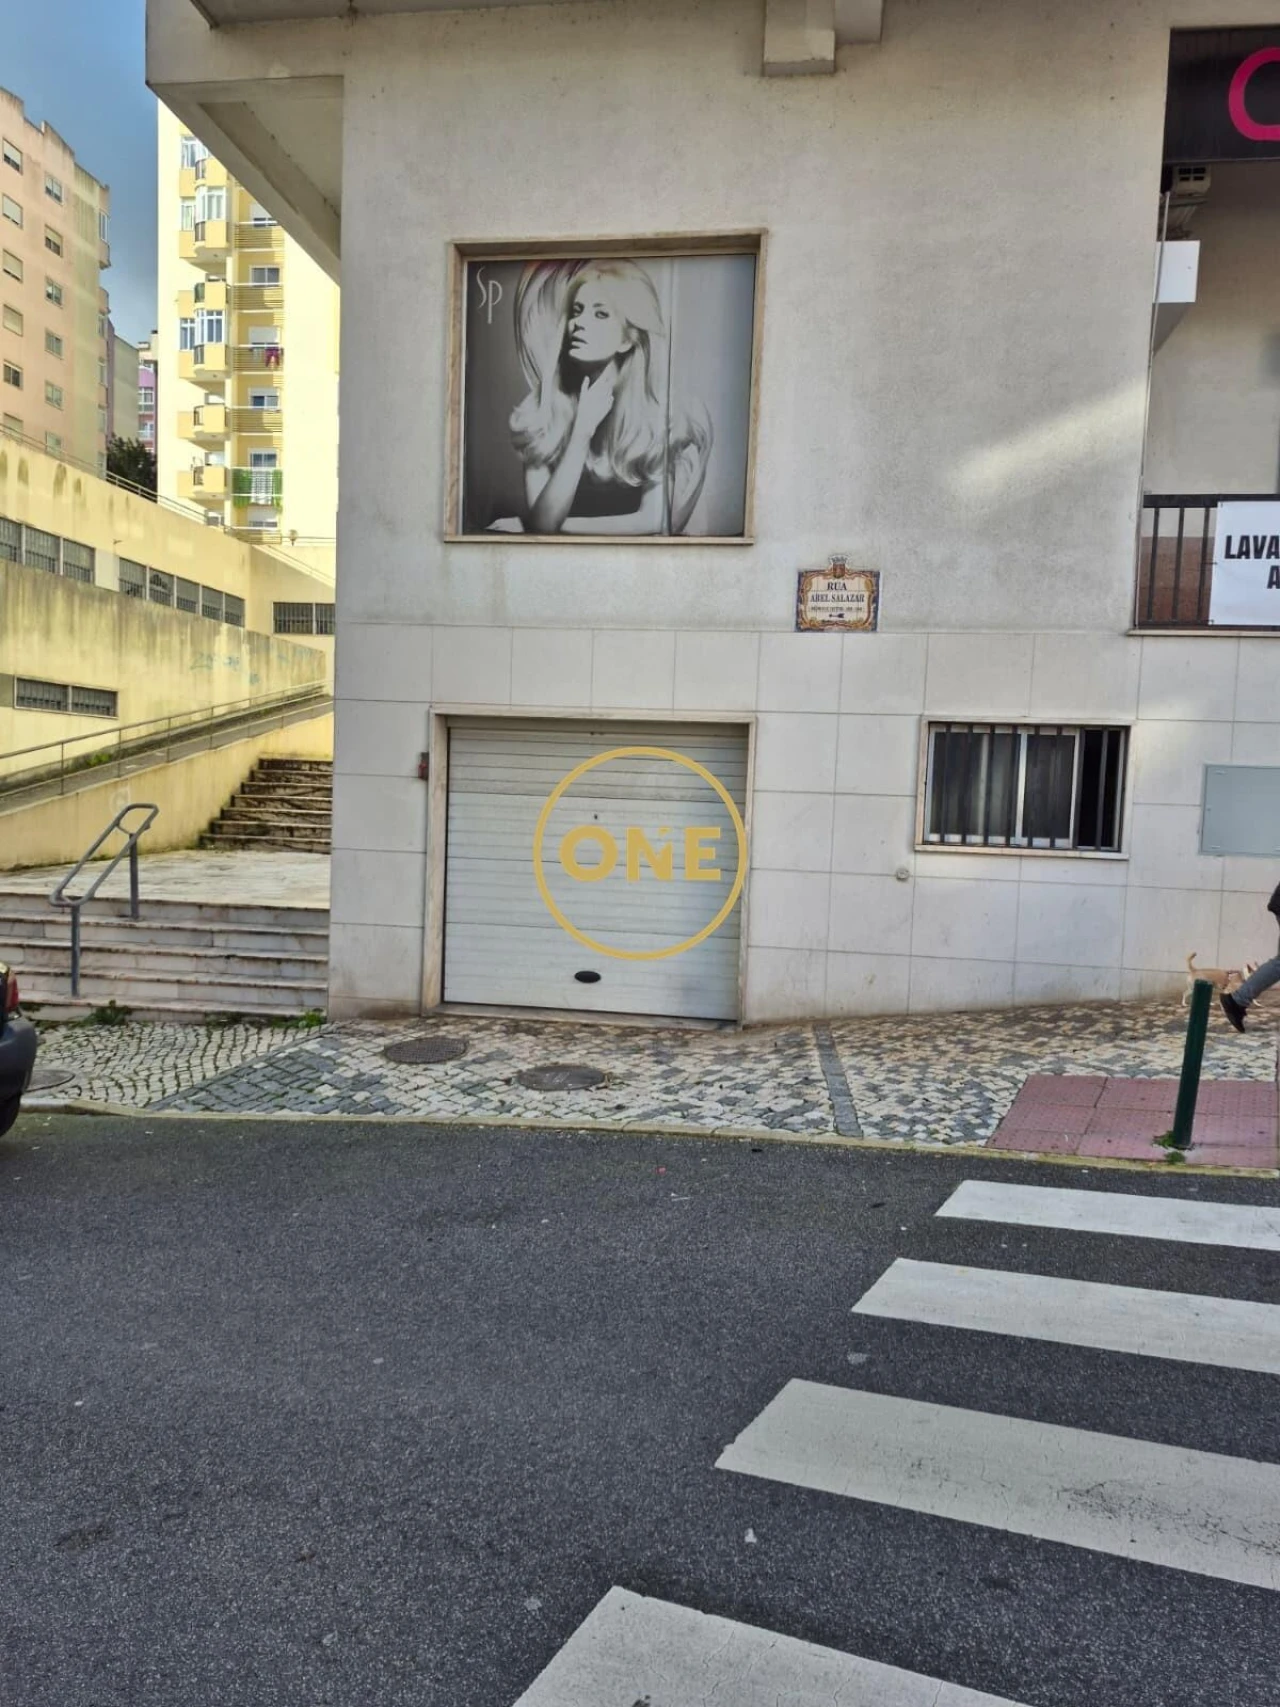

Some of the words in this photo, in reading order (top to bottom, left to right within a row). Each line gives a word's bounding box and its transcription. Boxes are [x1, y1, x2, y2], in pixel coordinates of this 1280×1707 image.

[827, 582, 847, 591] RUA
[811, 594, 829, 602] ABEL
[831, 594, 865, 602] SALAZAR
